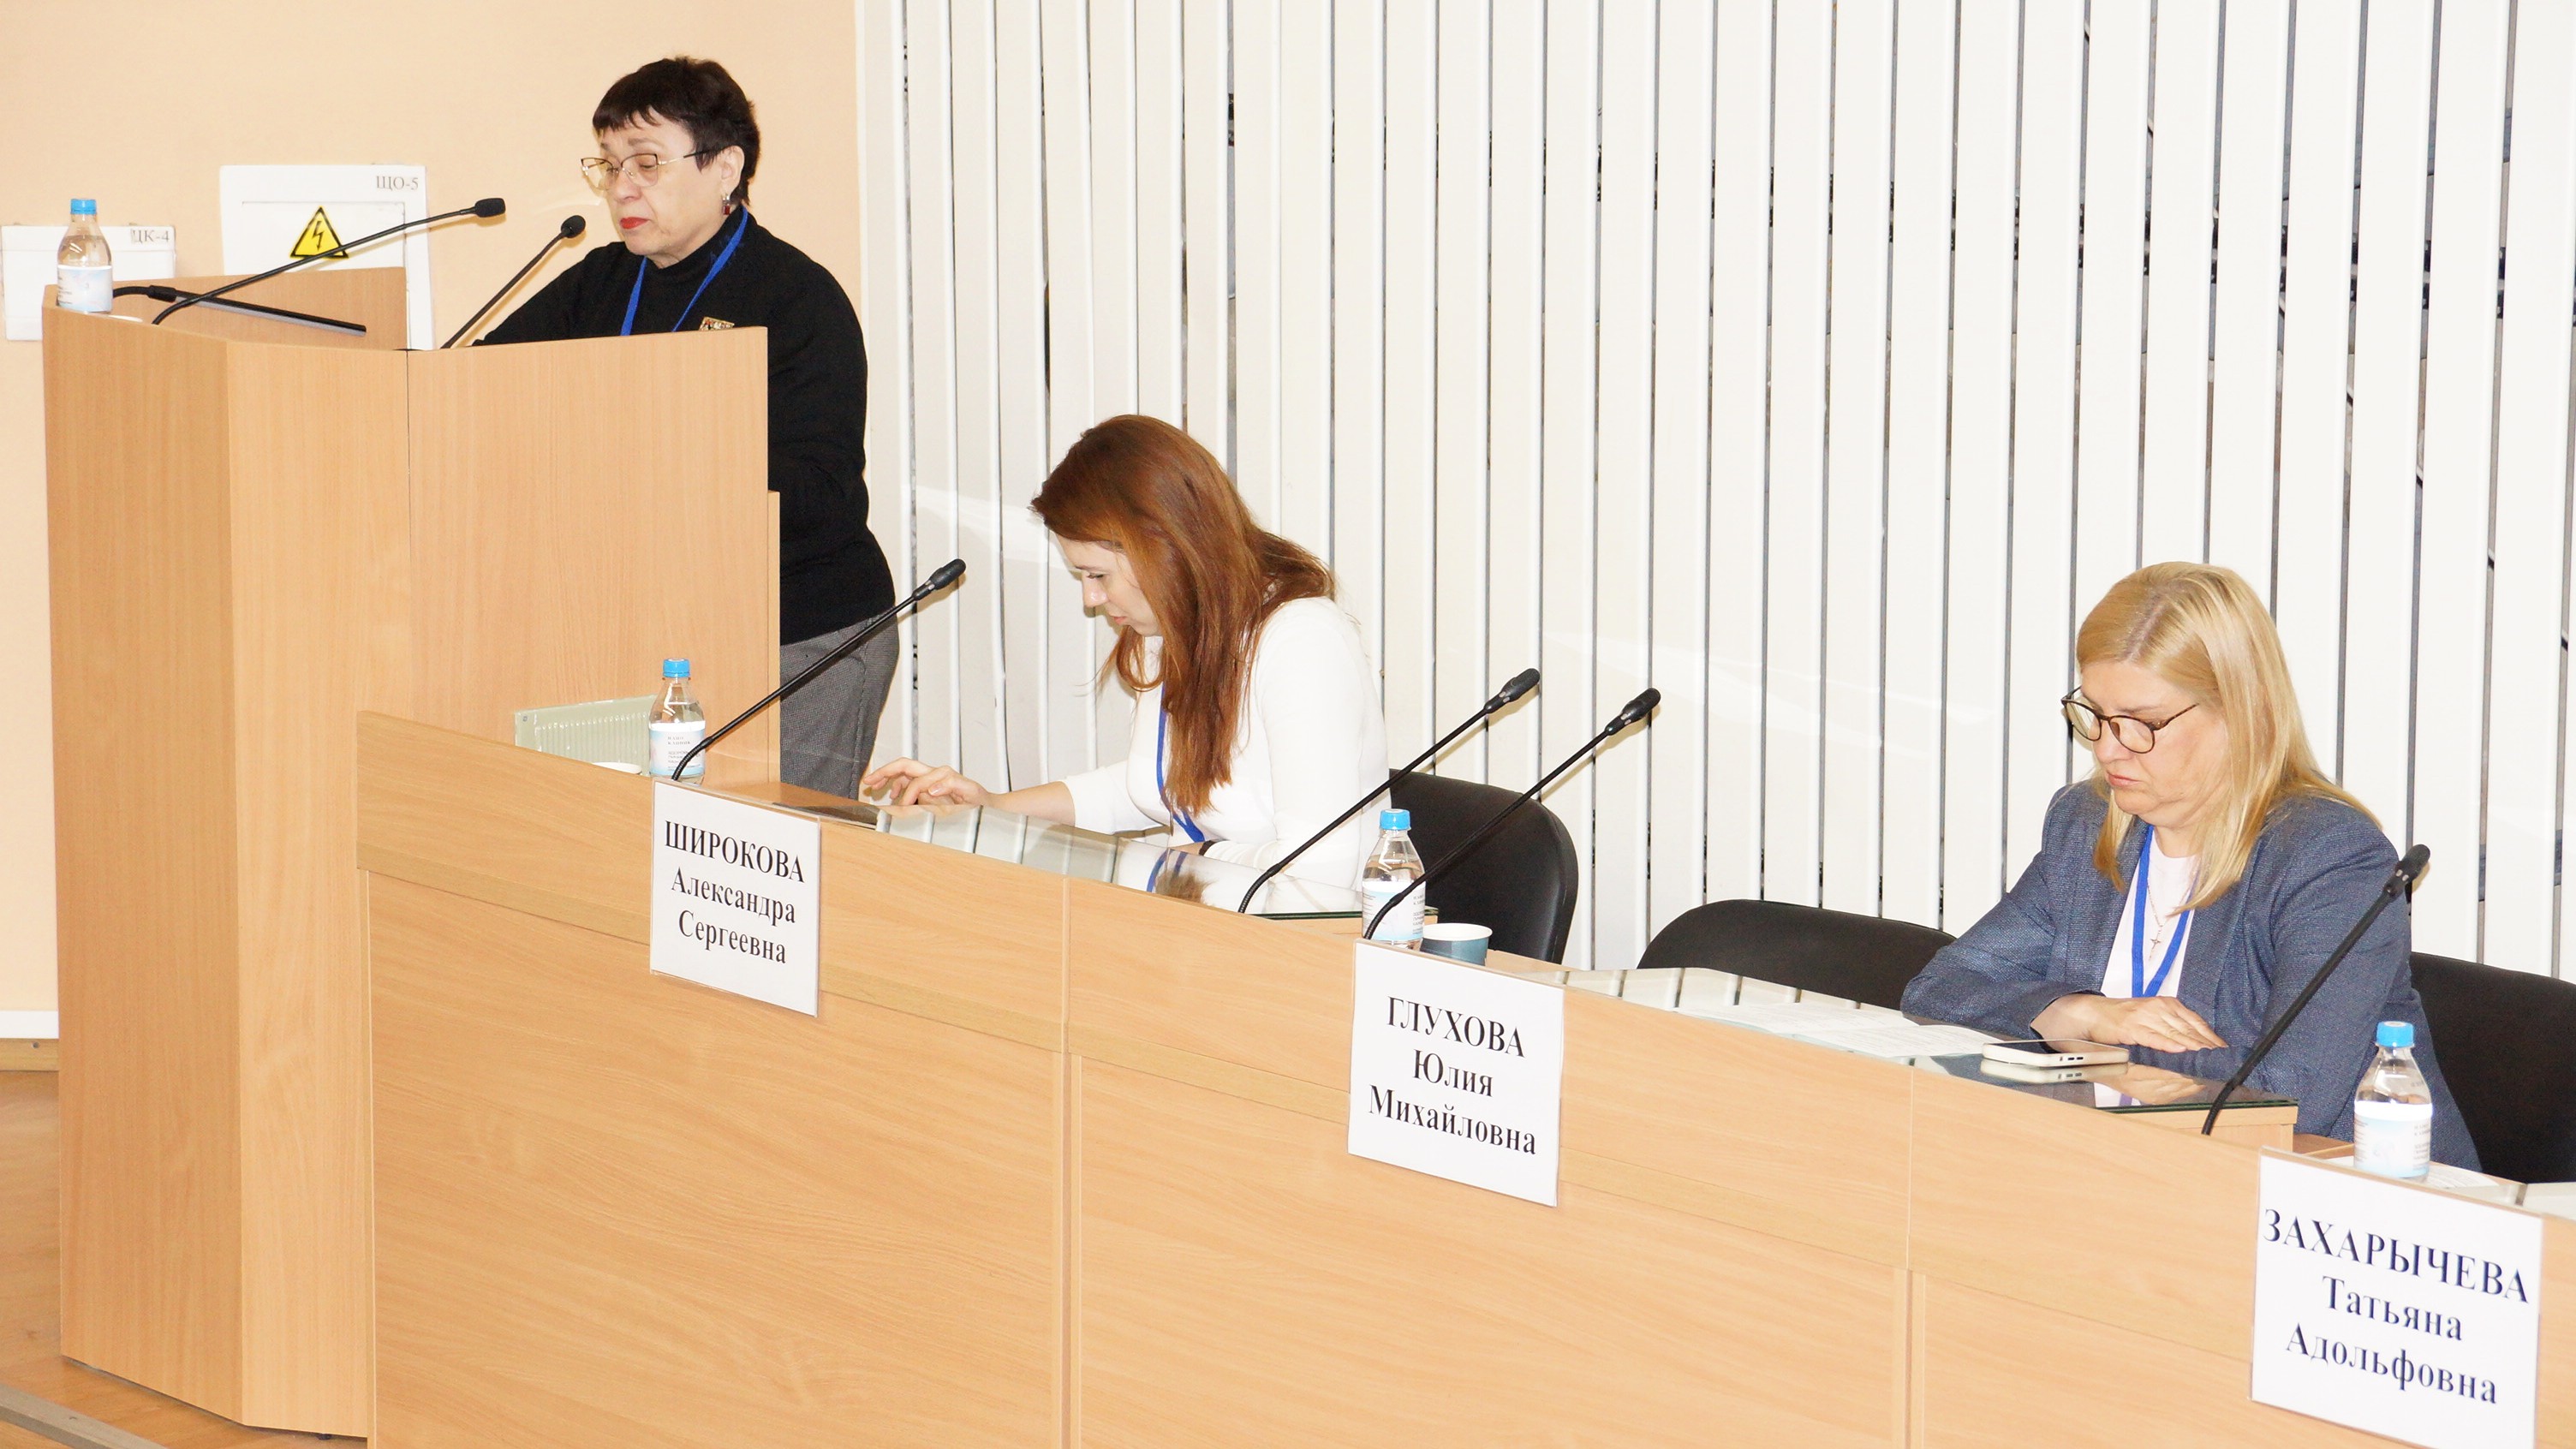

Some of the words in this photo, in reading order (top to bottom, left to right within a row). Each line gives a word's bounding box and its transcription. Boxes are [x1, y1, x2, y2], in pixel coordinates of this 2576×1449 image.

[376, 176, 419, 191] ЩО-5
[665, 820, 805, 883] ШИРОКОВА
[671, 868, 796, 927] Александра
[678, 909, 786, 964] Сергеевна
[1387, 996, 1525, 1058] ГЛУХОВА
[1412, 1050, 1493, 1097] Юлия
[1369, 1084, 1536, 1155] Михайловна
[2264, 1209, 2528, 1303] ЗАХАРЫЧЕВА
[2323, 1277, 2462, 1341] Татьяна
[2286, 1324, 2497, 1404] Адольфовна
